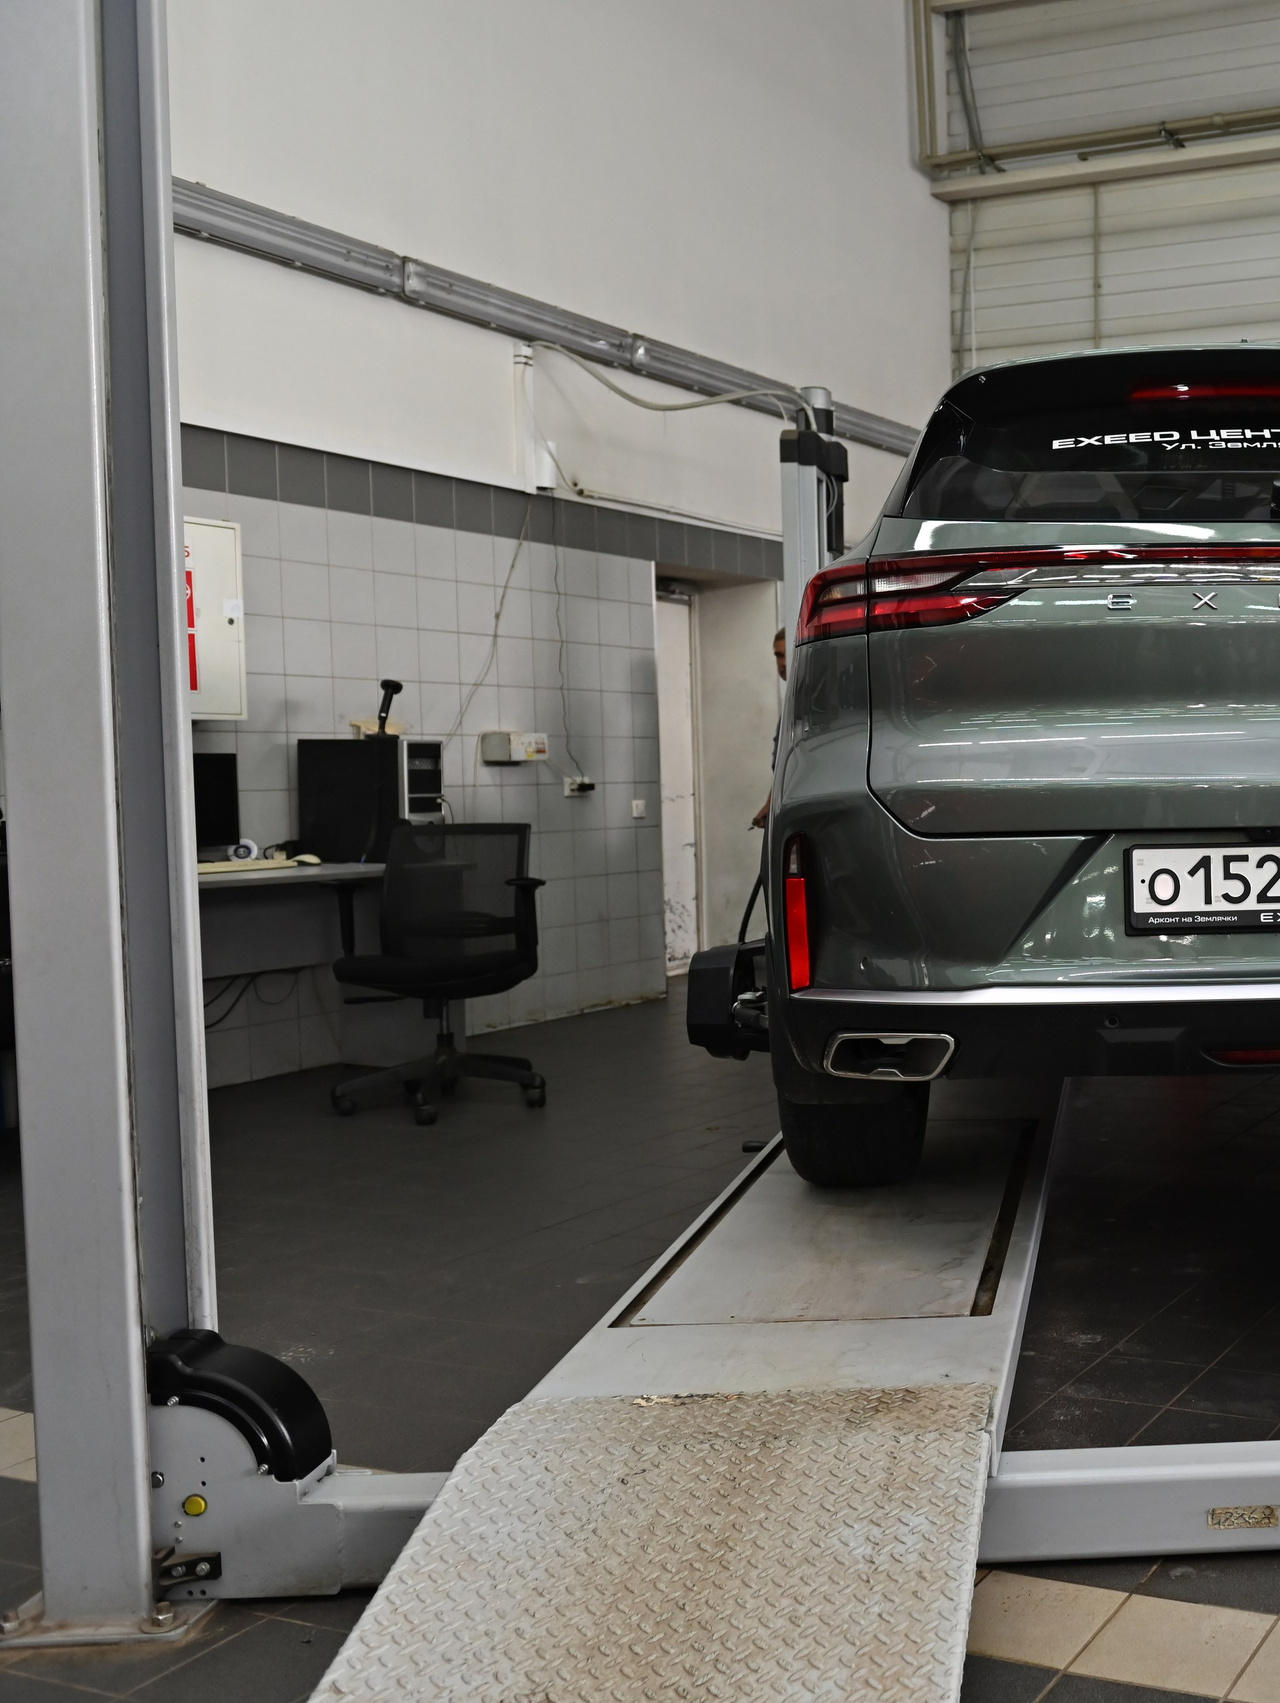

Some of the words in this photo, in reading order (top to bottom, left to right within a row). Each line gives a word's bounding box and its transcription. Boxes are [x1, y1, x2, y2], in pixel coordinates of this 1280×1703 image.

[1052, 431, 1181, 449] EXEED
[1148, 916, 1180, 924] Арконт
[1194, 915, 1238, 923] Землячки
